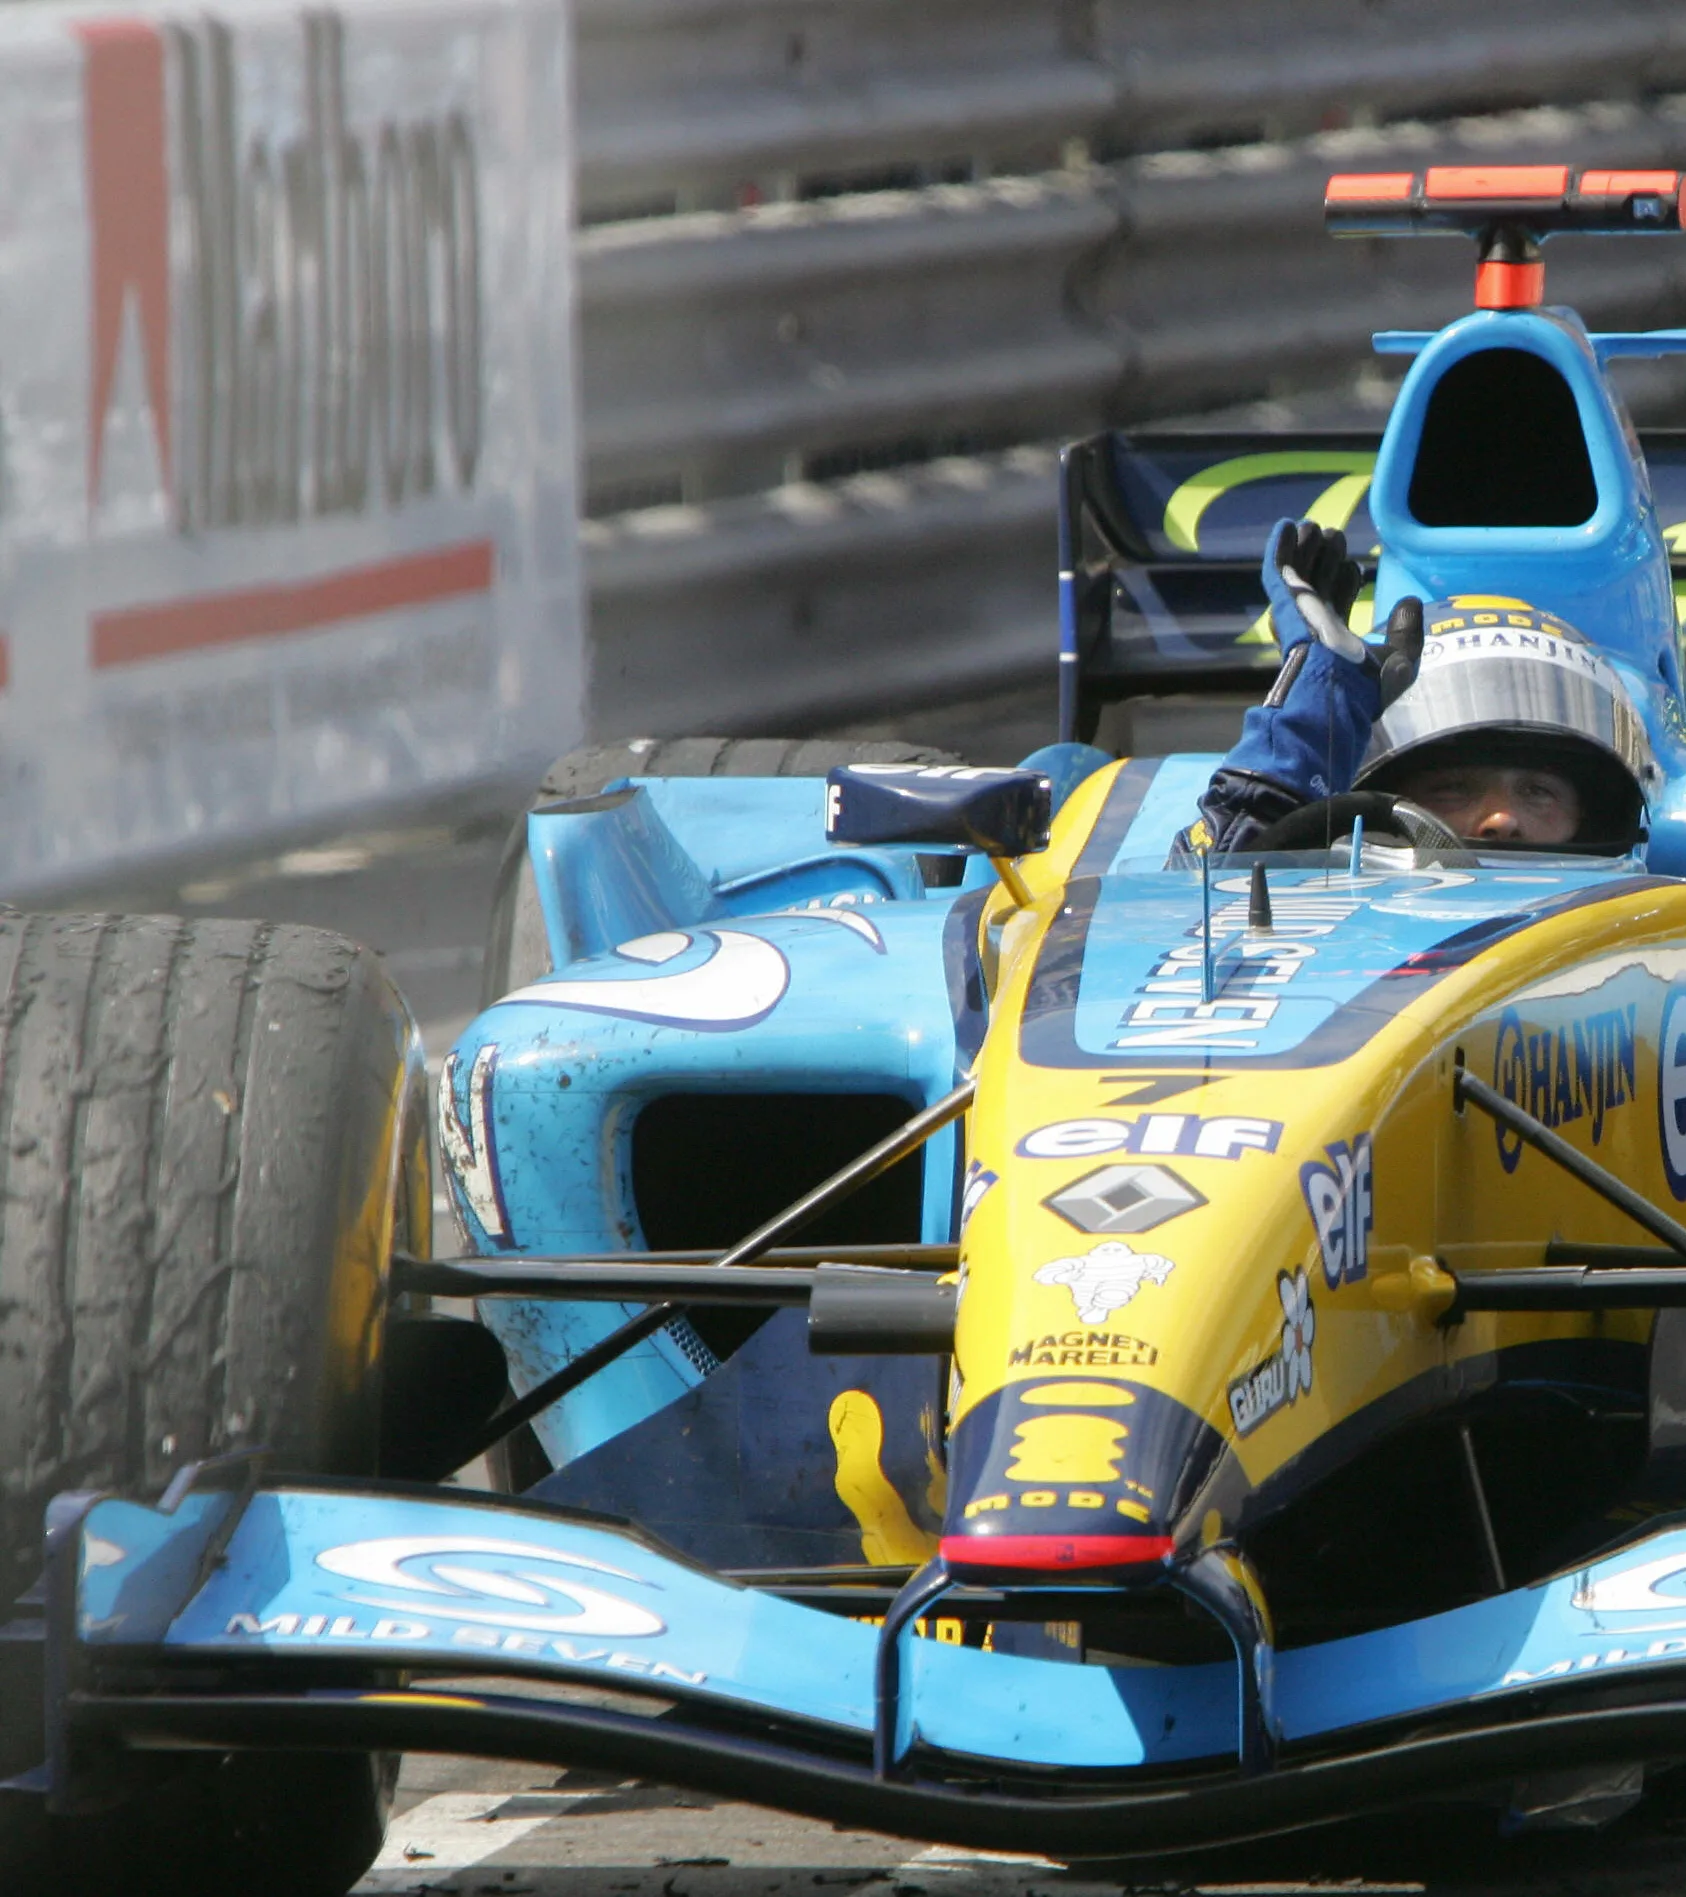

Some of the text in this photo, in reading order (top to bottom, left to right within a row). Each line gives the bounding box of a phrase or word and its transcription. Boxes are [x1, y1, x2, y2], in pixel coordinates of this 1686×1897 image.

[1456, 632, 1597, 676] HANJIN
[1099, 1075, 1235, 1107] 7
[1526, 1003, 1636, 1145] HANJIN
[1015, 1113, 1284, 1160] elf
[1300, 1132, 1373, 1290] elf
[1008, 1346, 1158, 1367] MARELLI
[225, 1613, 709, 1685] MILD SEVEN
